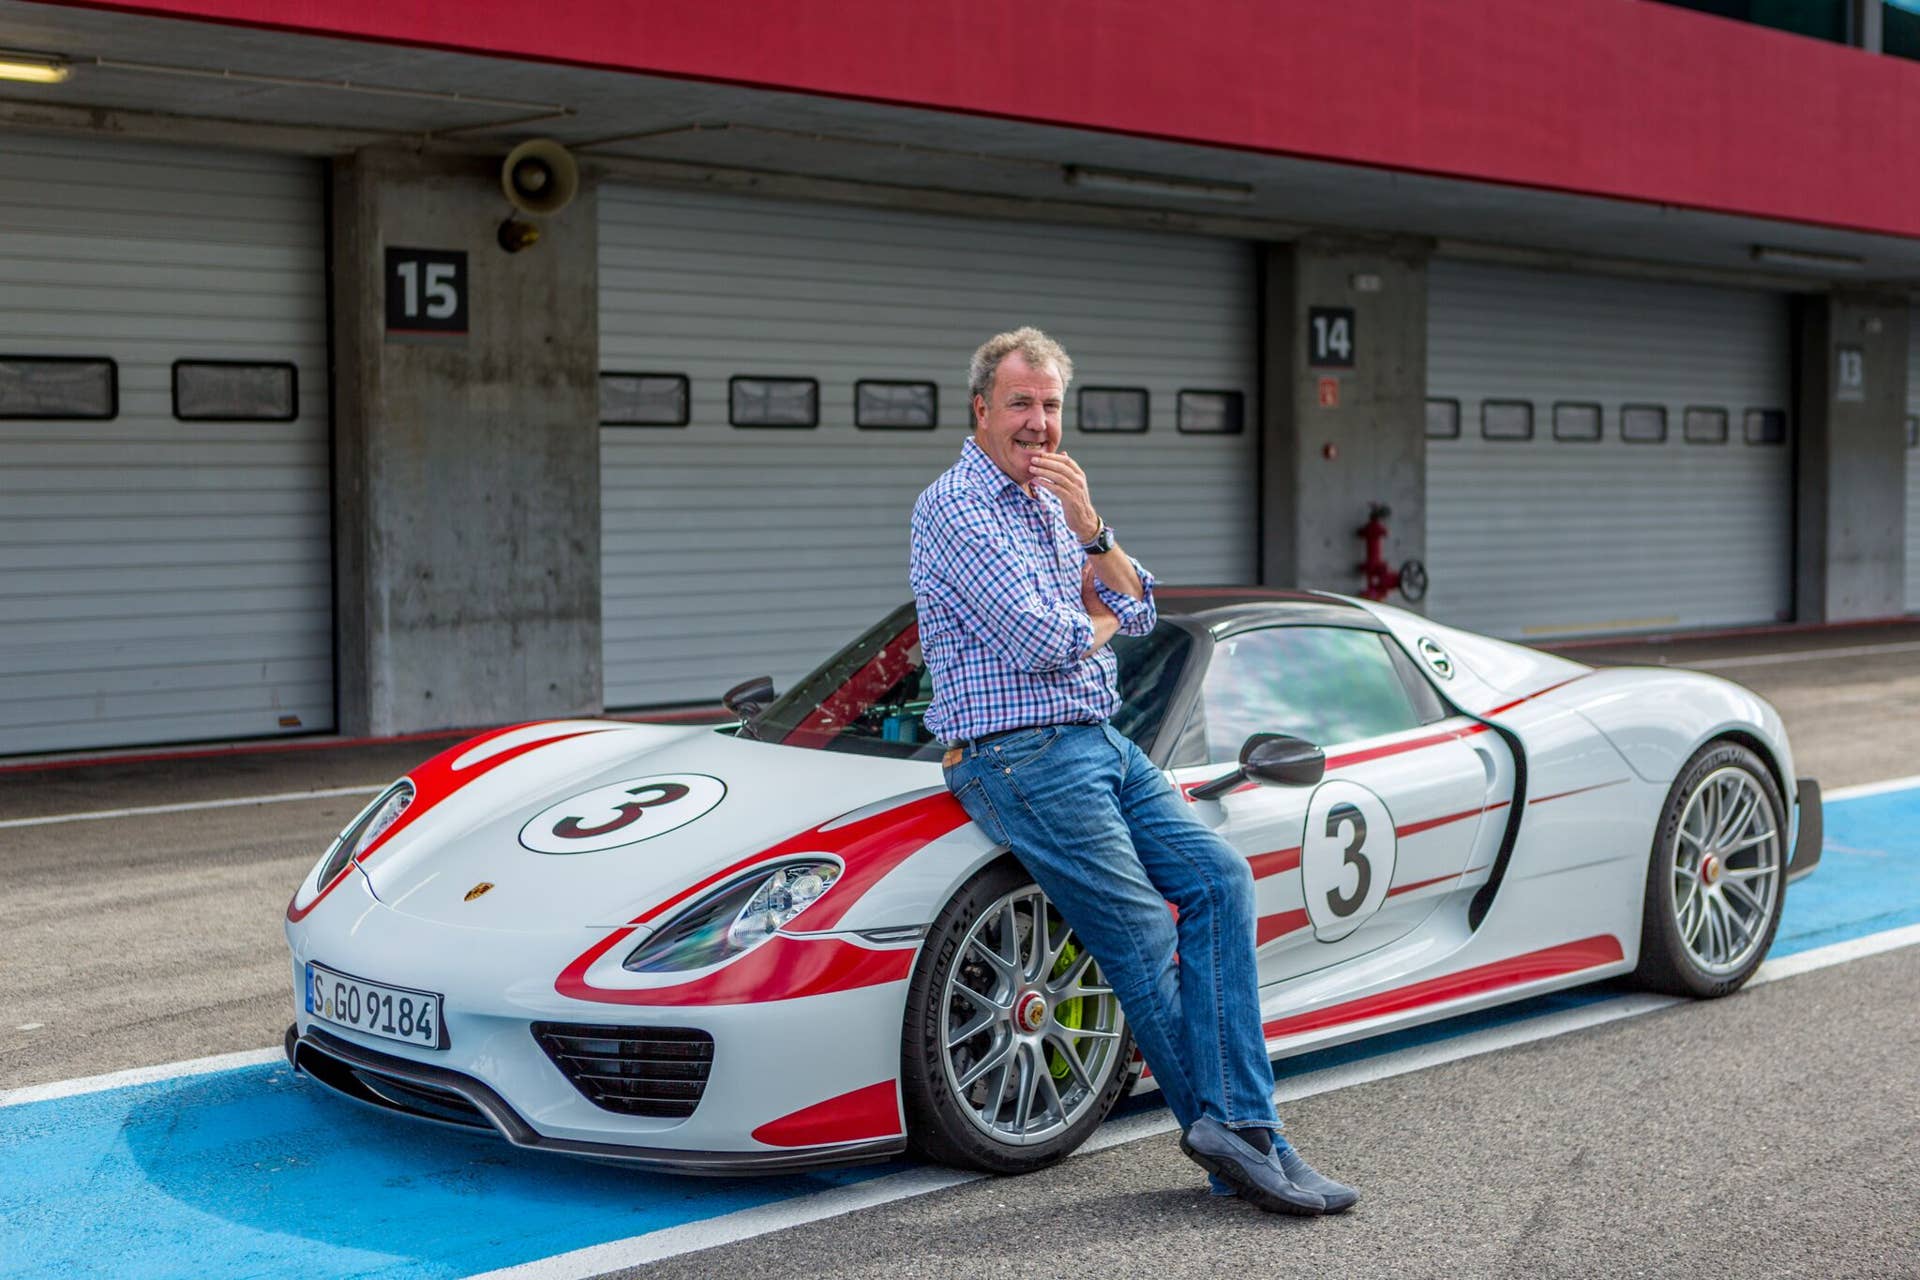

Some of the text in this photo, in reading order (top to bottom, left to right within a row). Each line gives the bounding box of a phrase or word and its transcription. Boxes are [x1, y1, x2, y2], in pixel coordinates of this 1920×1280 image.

[397, 261, 458, 319] 15
[1313, 317, 1352, 359] 14
[552, 783, 690, 839] 3
[1325, 801, 1372, 918] 3
[314, 974, 433, 1041] S GO 9184
[926, 937, 957, 1039] MICHELIN
